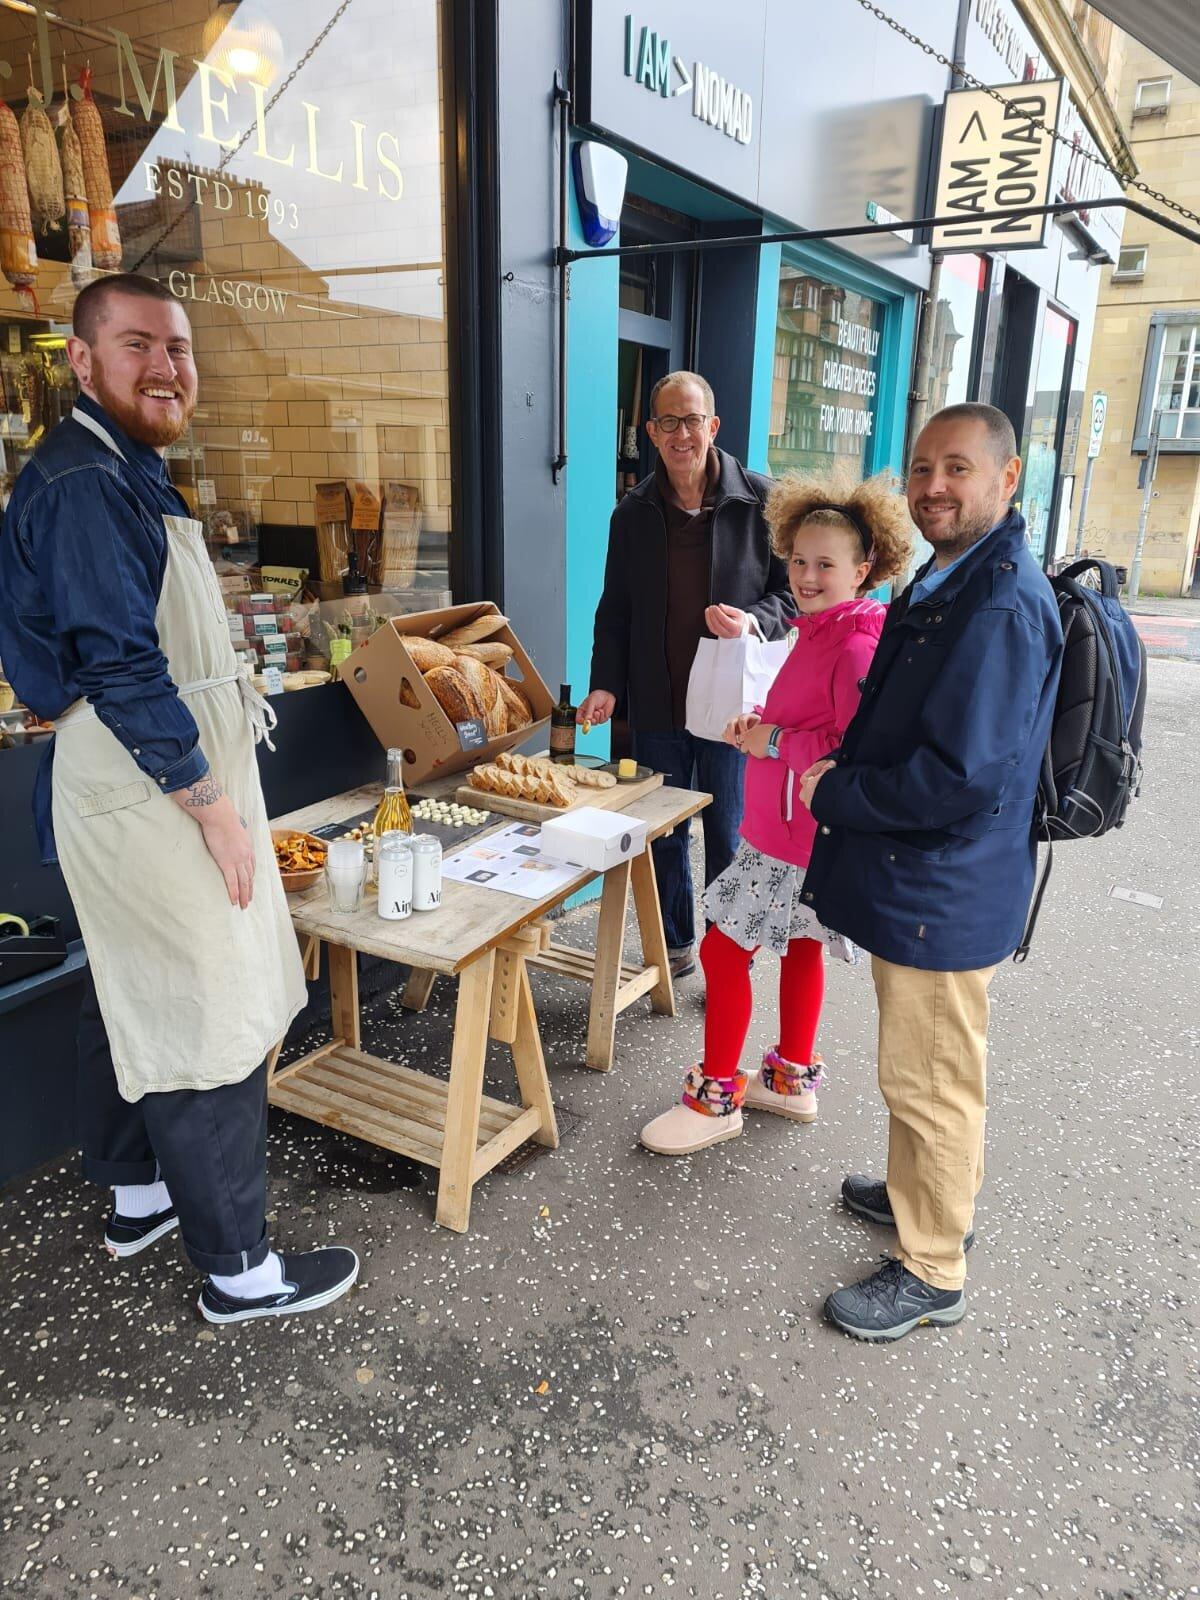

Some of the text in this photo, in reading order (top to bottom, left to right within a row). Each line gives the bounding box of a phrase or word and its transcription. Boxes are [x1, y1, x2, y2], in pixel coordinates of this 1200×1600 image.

[636, 26, 671, 98] AM
[693, 61, 752, 145] NOMAD
[107, 27, 404, 202] MELLIS
[946, 157, 991, 213] AM
[990, 95, 1047, 234] NOMAD
[144, 162, 300, 231] ESTD 1993
[168, 270, 289, 317] GLASGOW
[837, 318, 880, 356] BEAUTIFULLY
[822, 360, 876, 397] CURATED PIECES
[820, 404, 874, 436] FOR YOUR HOME
